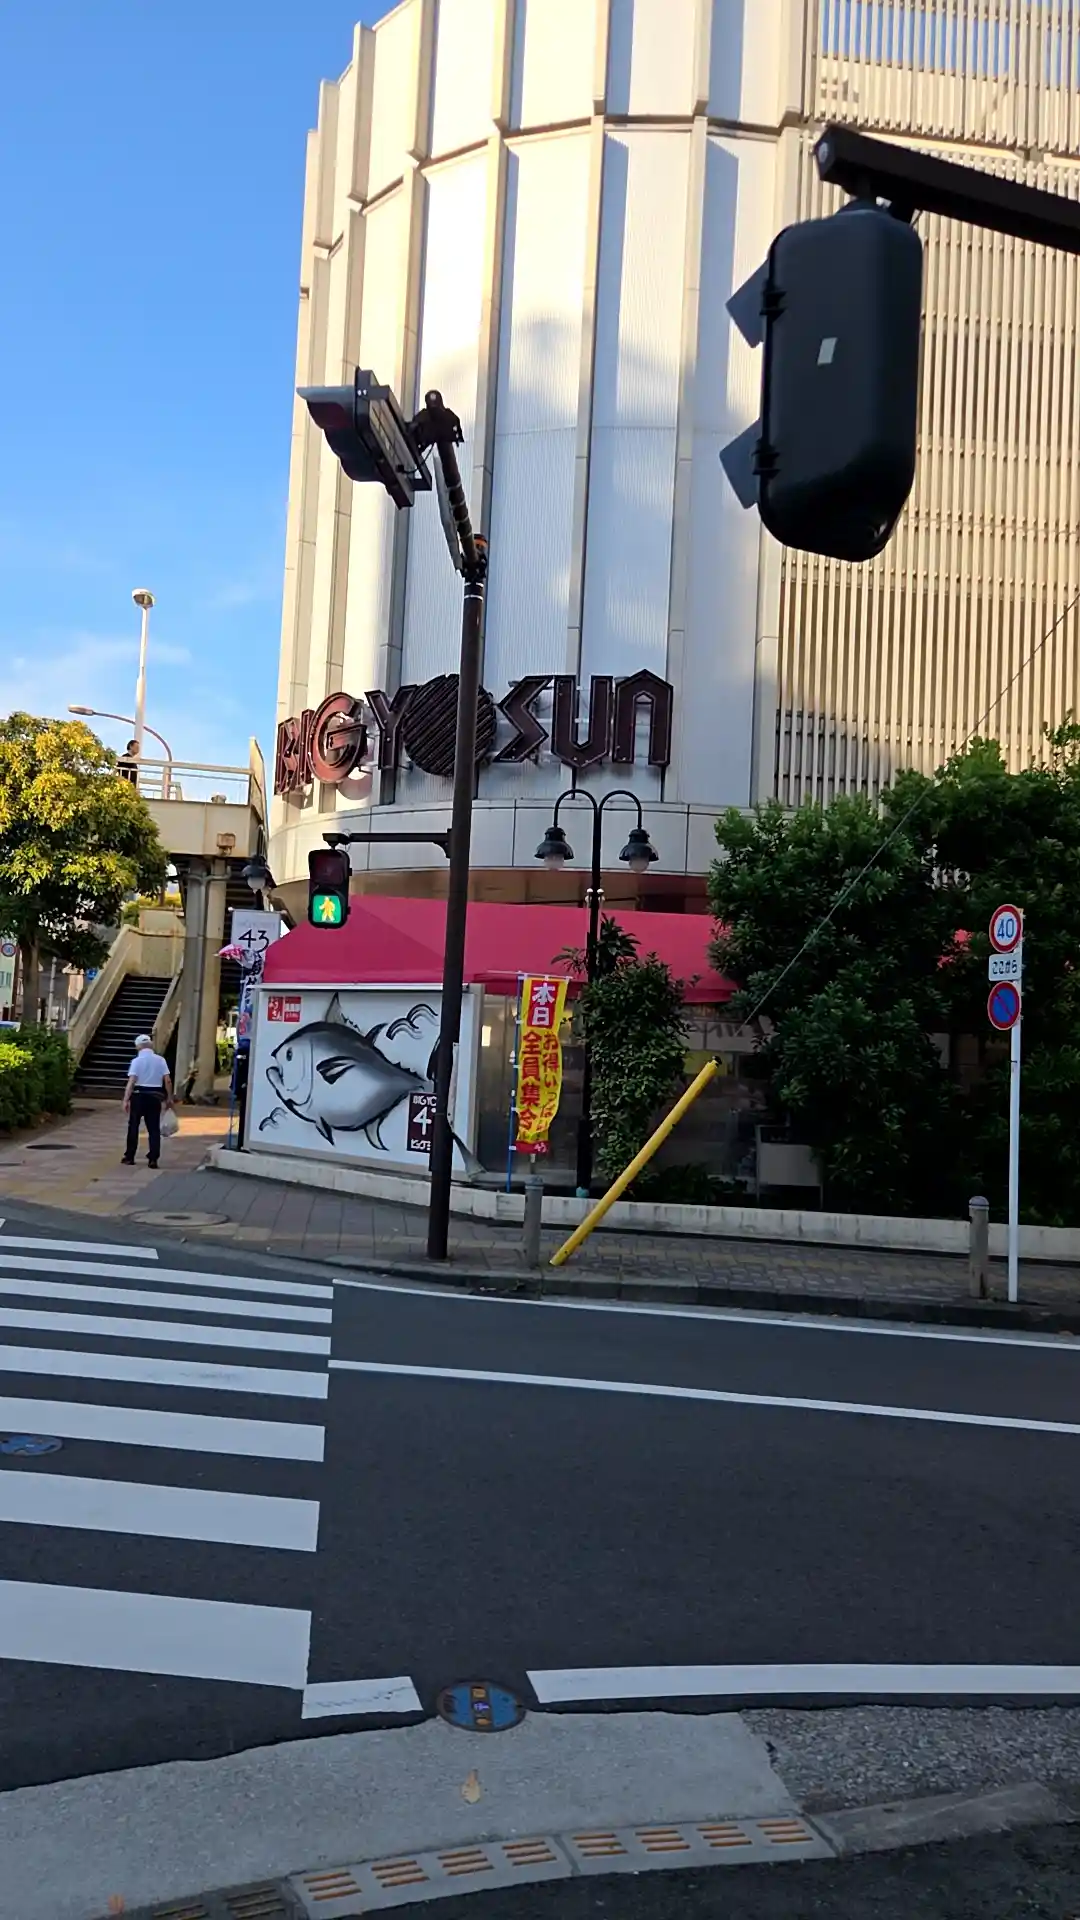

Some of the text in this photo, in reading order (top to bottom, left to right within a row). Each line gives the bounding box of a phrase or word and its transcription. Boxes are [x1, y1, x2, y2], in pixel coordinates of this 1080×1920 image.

[997, 917, 1015, 939] 40
[238, 929, 270, 953] 43
[531, 982, 556, 1026] 本日
